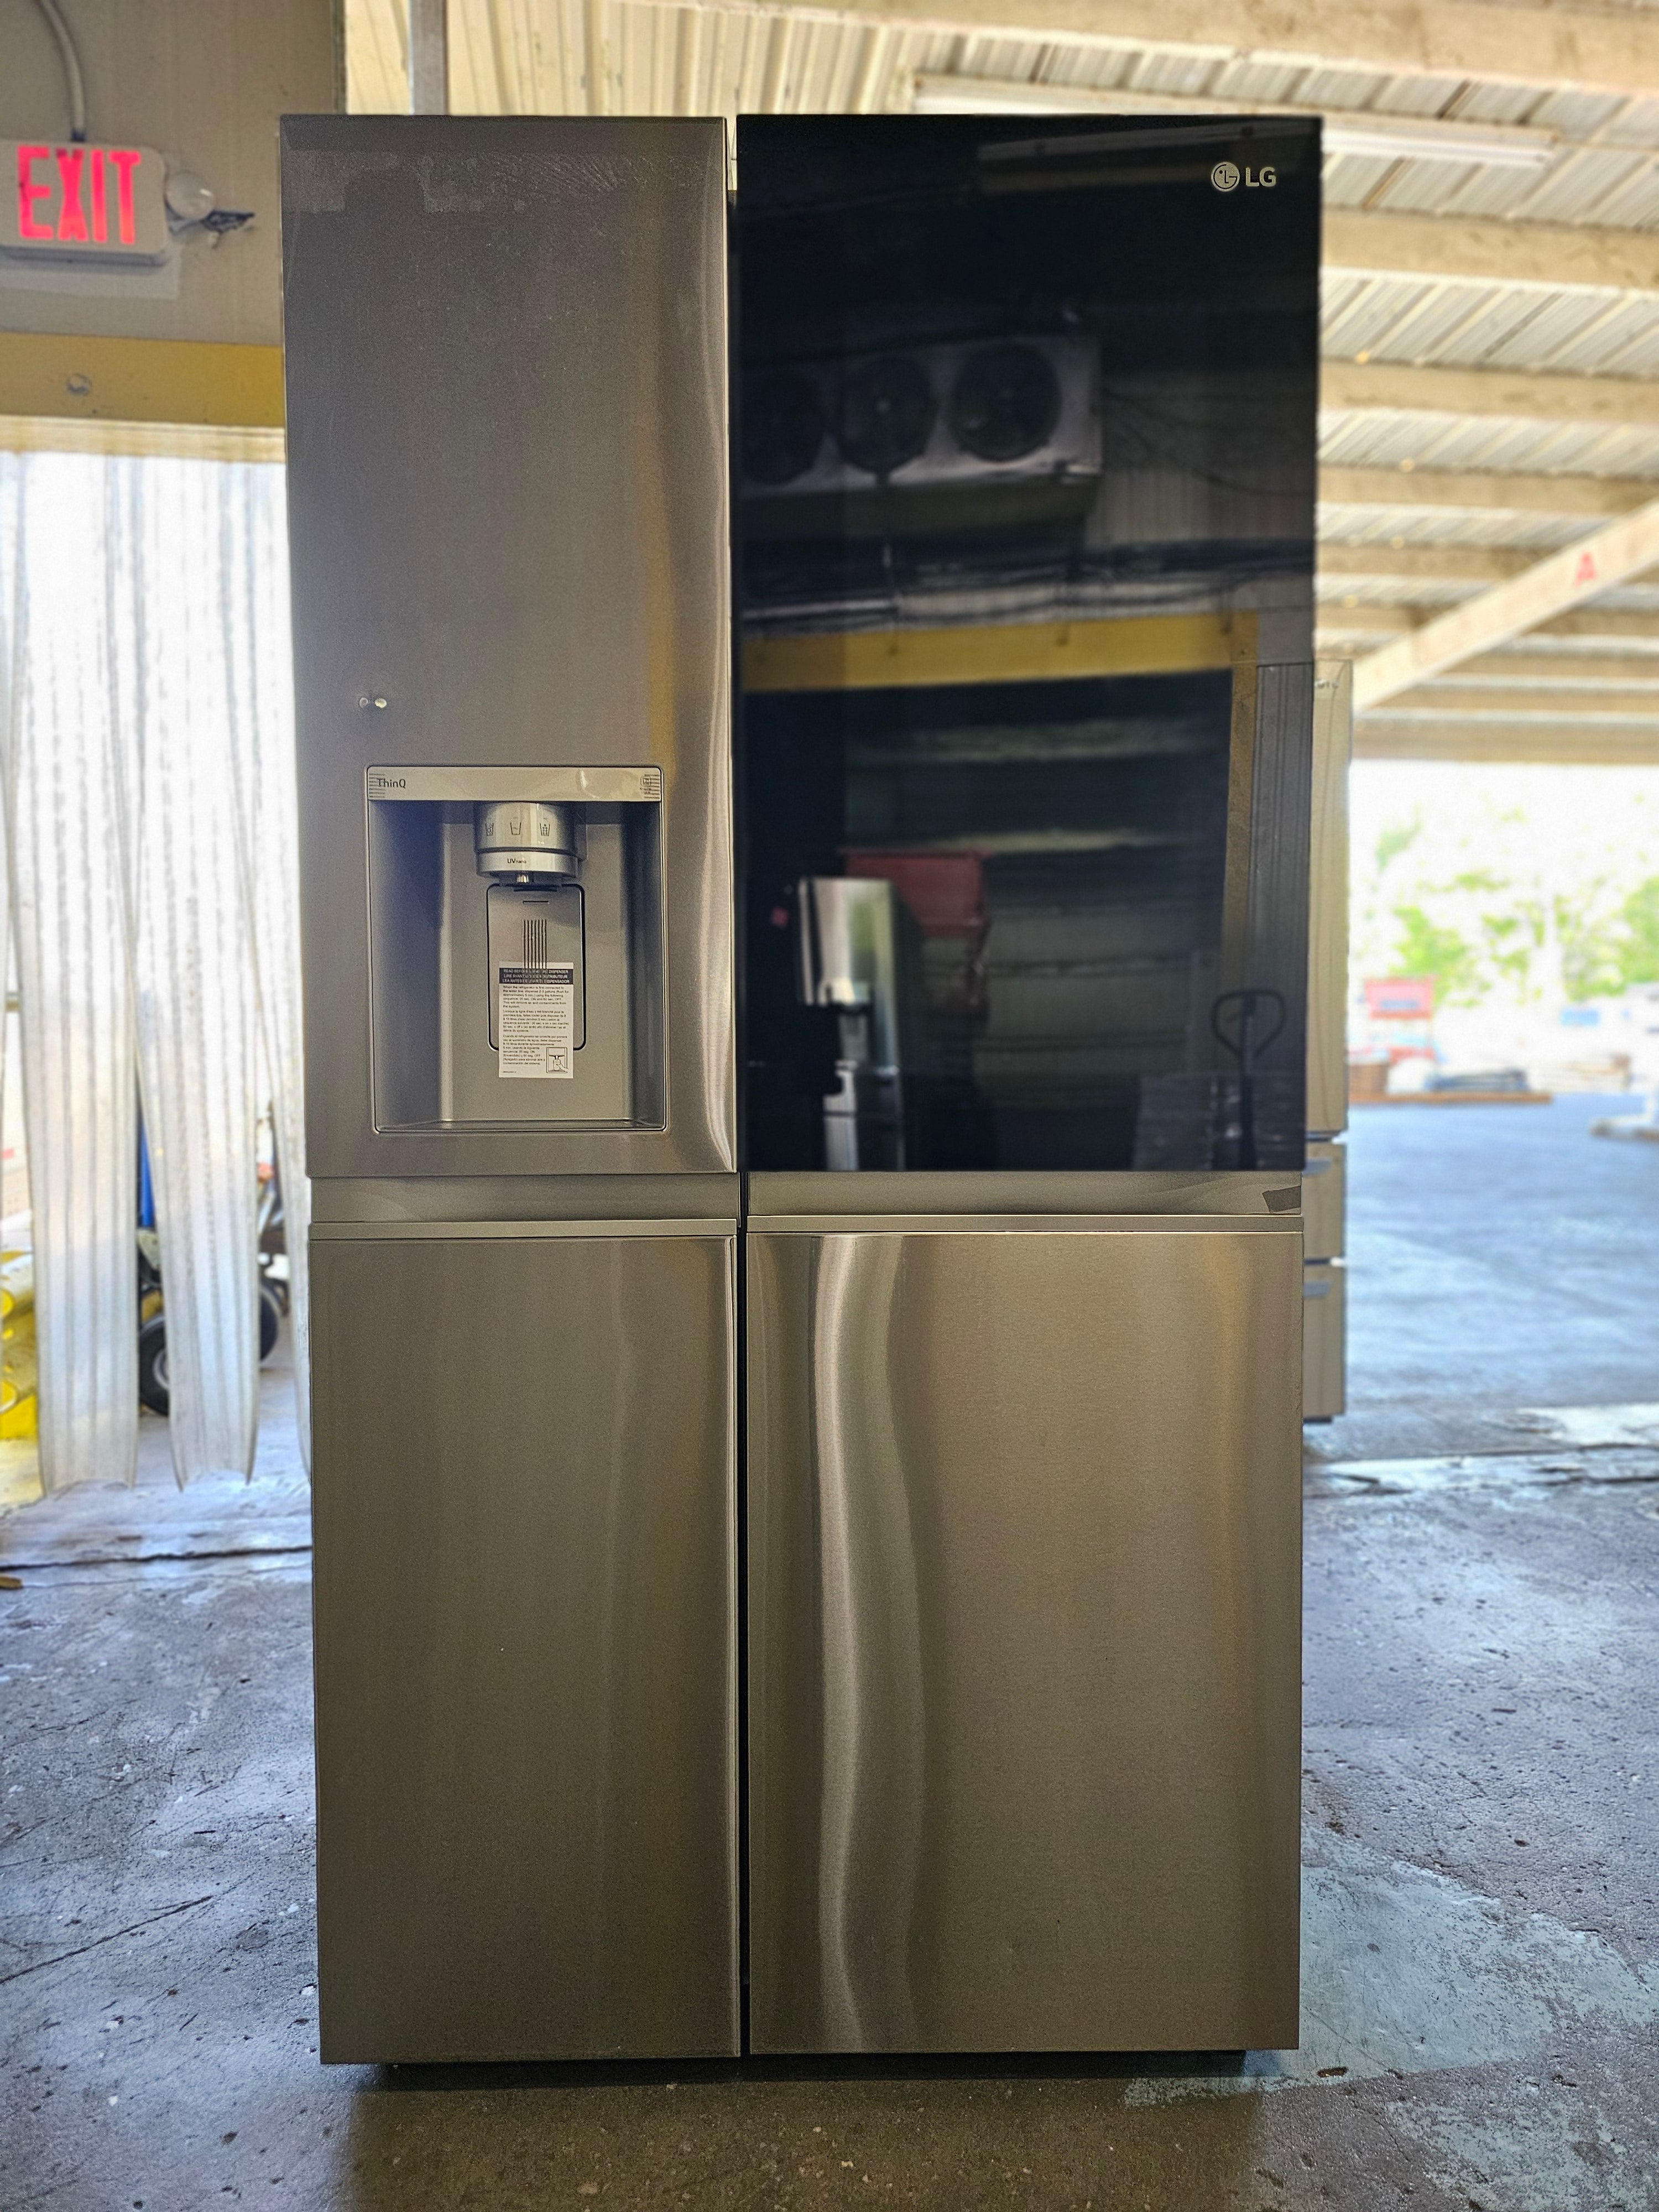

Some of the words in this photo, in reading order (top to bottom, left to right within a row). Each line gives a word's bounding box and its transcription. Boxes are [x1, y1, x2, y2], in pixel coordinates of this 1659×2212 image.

[1245, 166, 1276, 187] LG
[18, 145, 142, 245] EXIT
[377, 779, 406, 789] ThinQ
